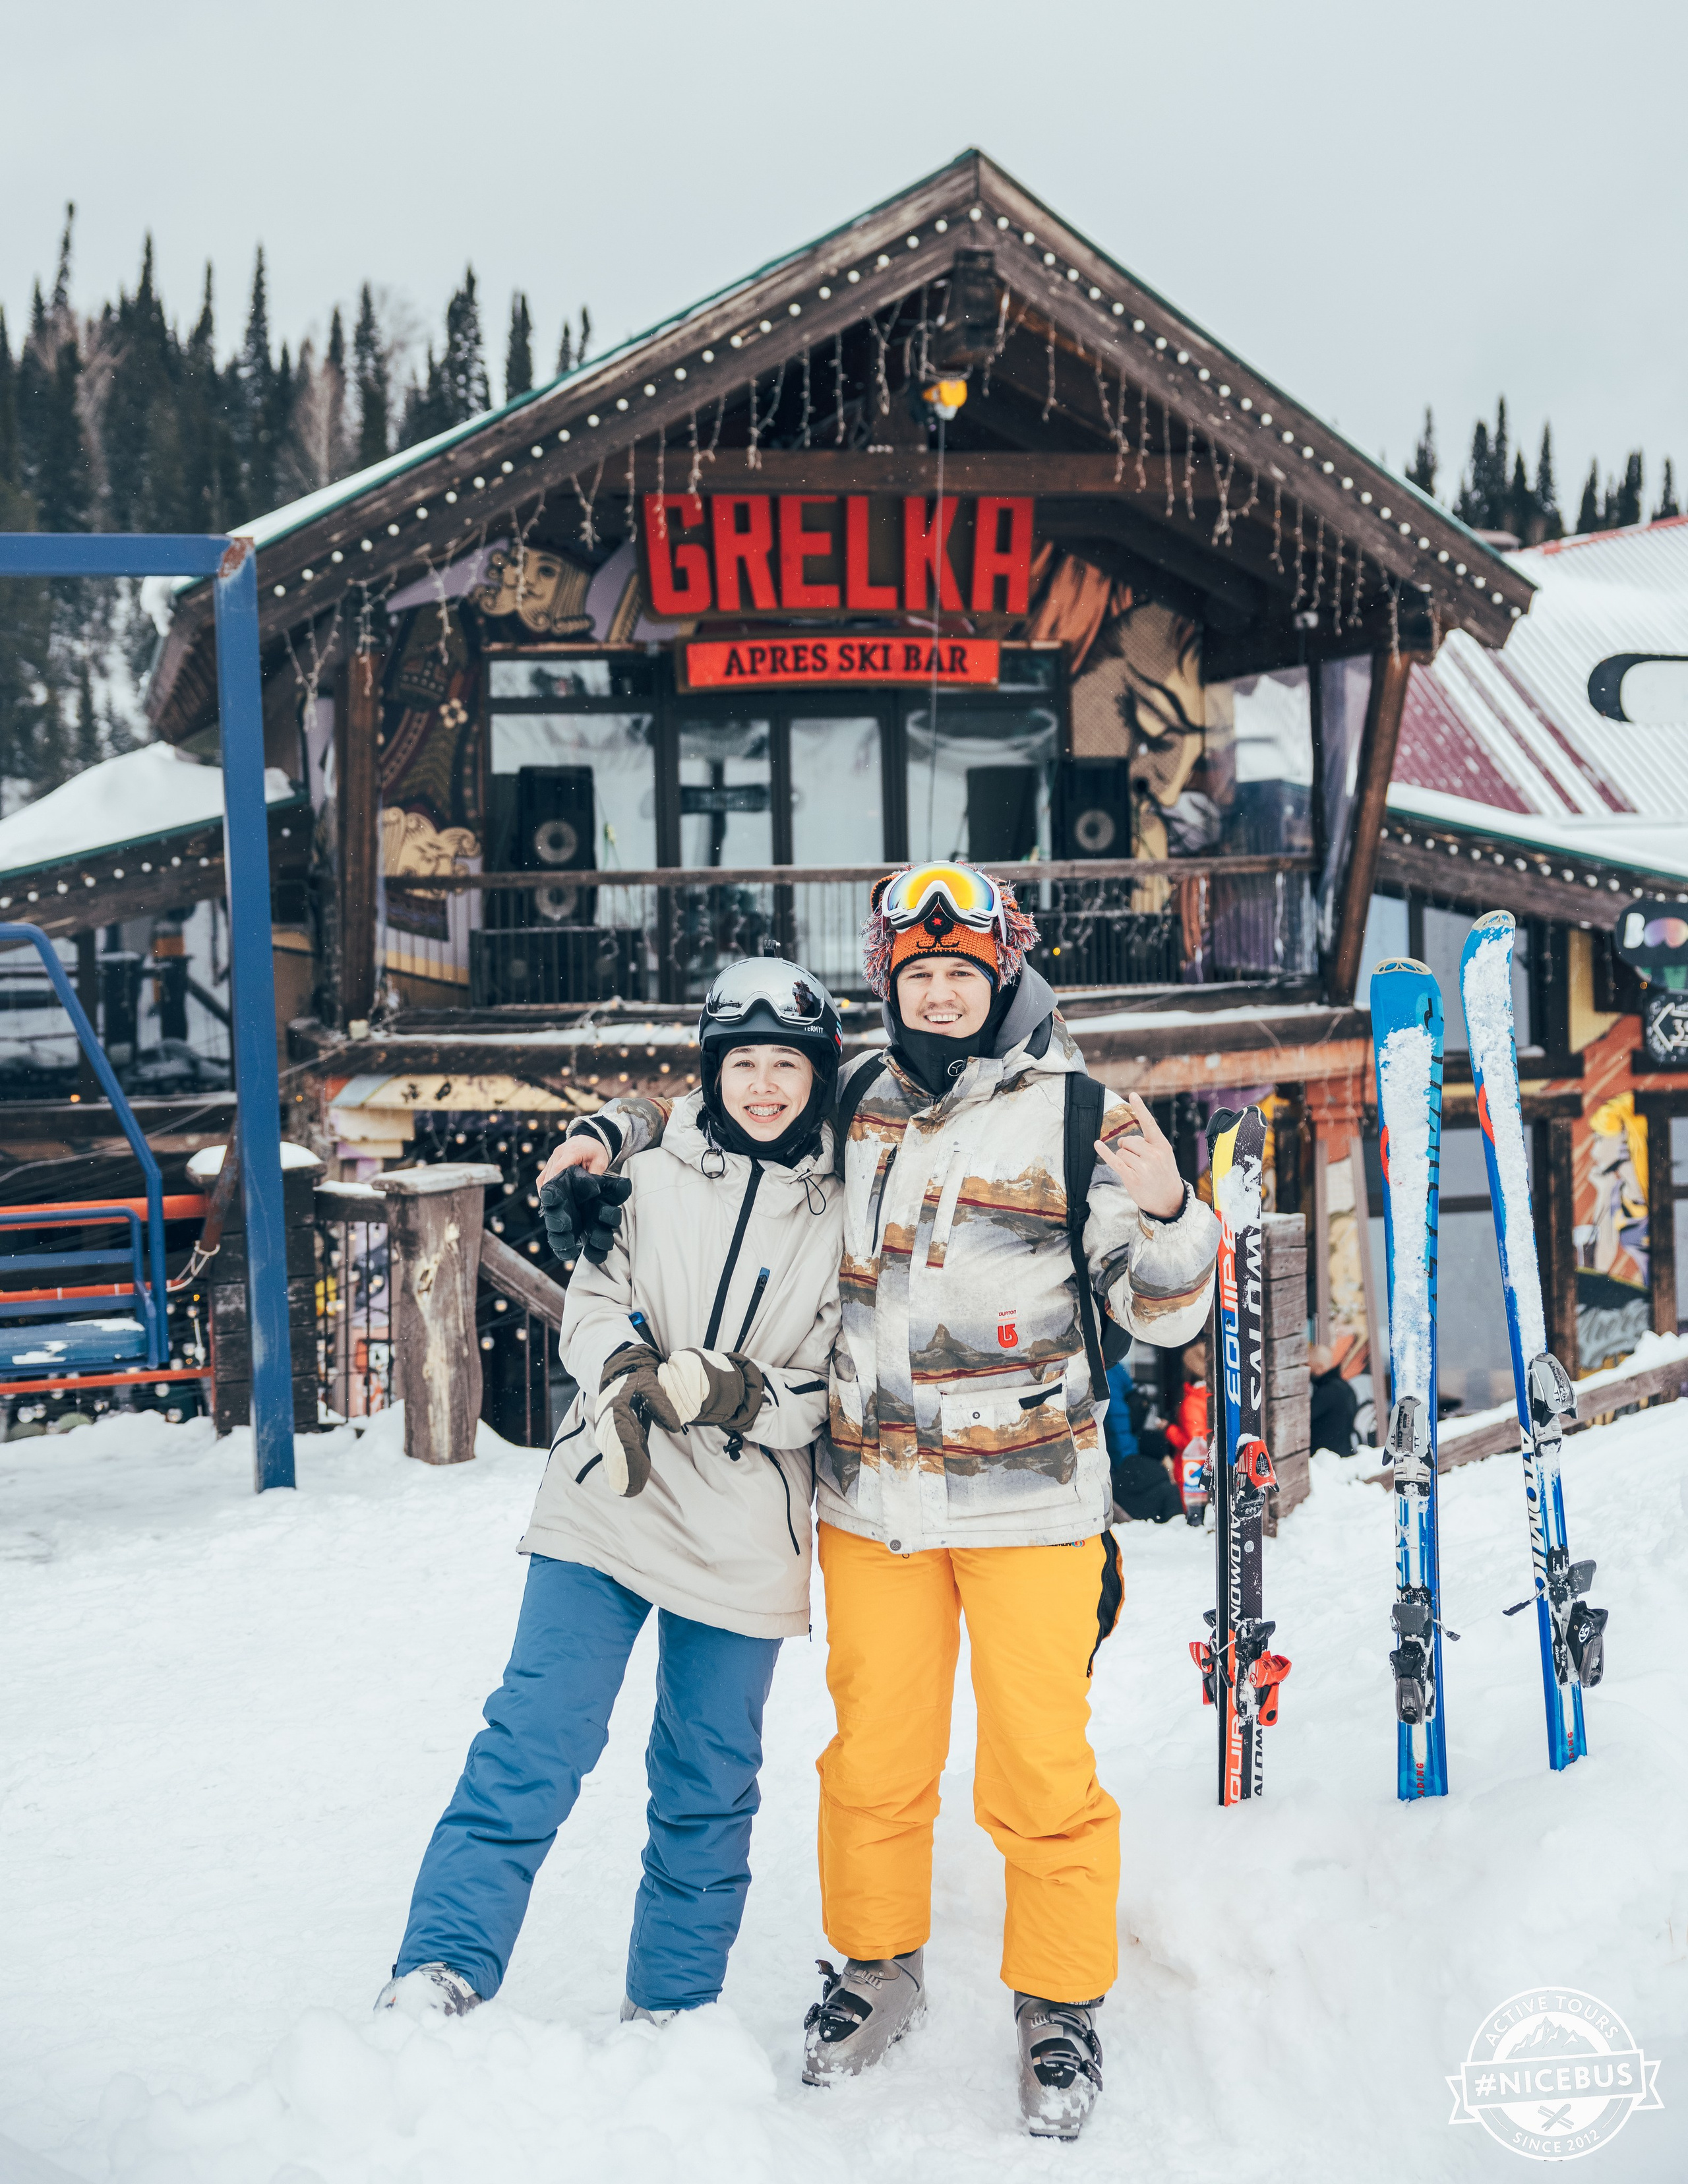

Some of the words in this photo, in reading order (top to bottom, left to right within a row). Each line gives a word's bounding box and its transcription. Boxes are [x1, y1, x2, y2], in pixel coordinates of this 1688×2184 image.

[643, 493, 1035, 615] GRELKA
[723, 642, 829, 677] APRES
[838, 643, 891, 673] SKI
[904, 644, 969, 674] BAR
[1242, 1154, 1262, 1411] SALOMN
[1519, 1422, 1549, 1602] ATOMIC
[1230, 1714, 1244, 1804] QUIP
[1416, 1763, 1425, 1798] ADING
